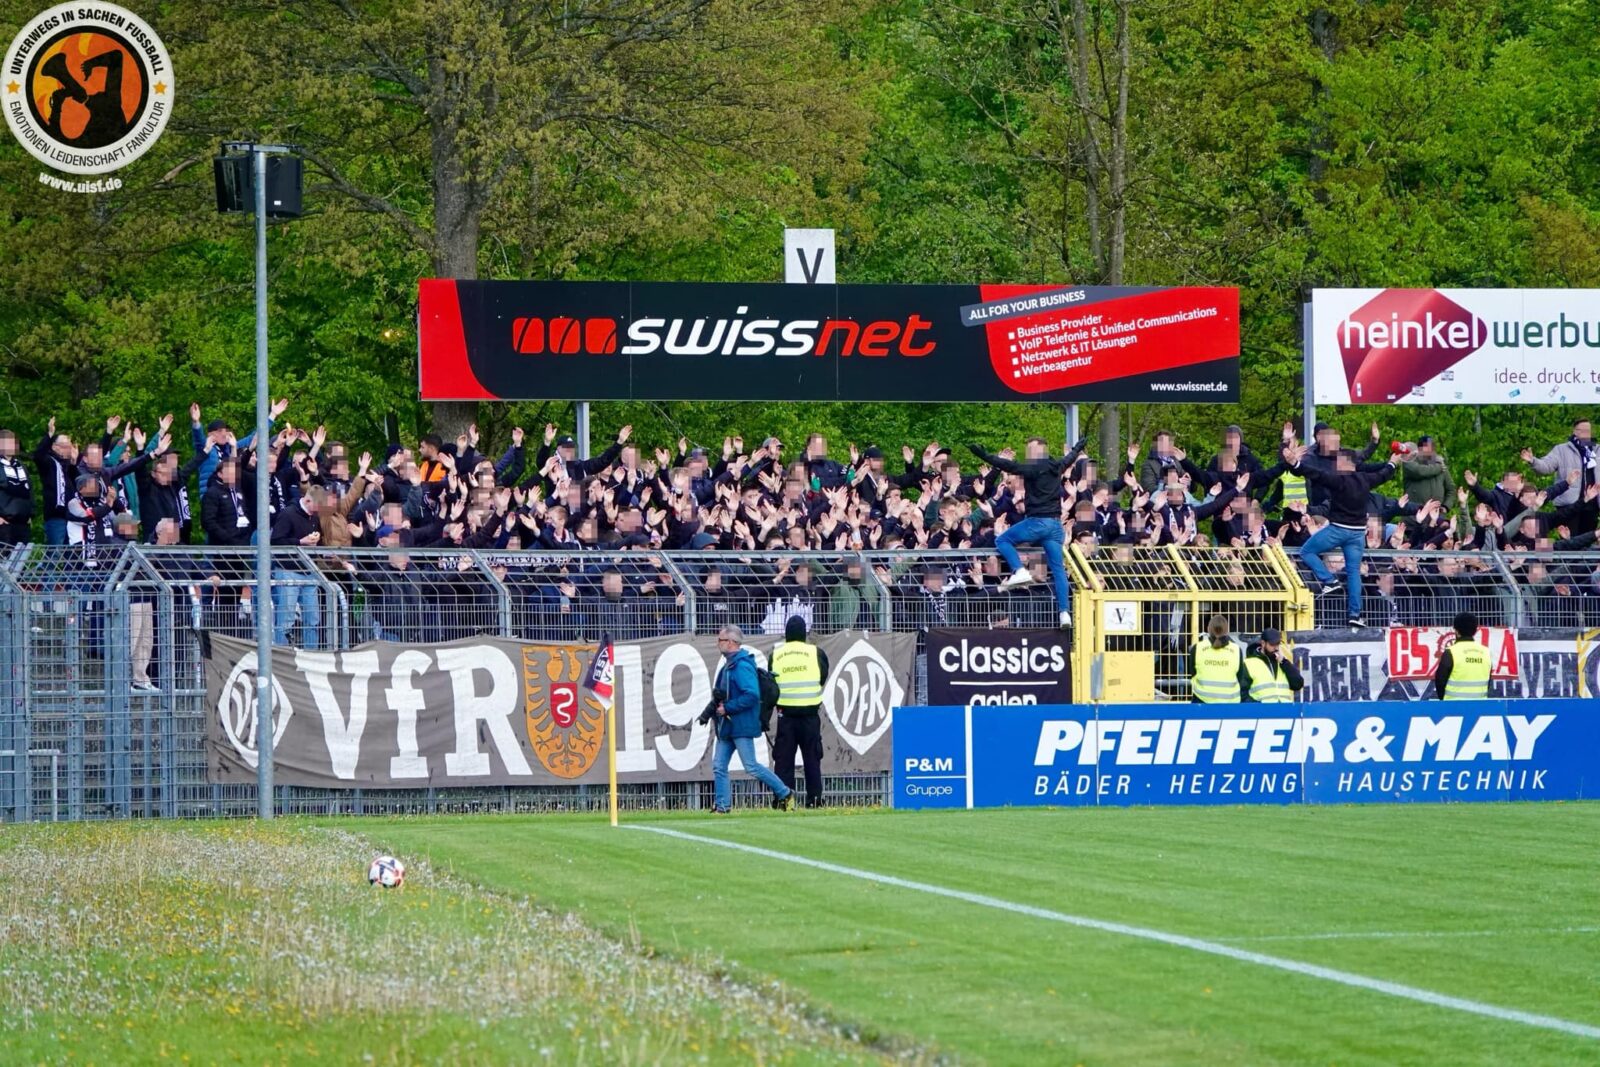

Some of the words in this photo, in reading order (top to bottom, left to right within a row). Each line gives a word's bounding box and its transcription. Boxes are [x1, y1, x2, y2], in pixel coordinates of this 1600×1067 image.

[796, 247, 825, 284] V
[968, 307, 988, 321] ALL
[989, 304, 1009, 318] FOR
[1010, 300, 1039, 314] YOUR
[1039, 291, 1086, 309] BUSINESS
[621, 305, 937, 356] swissnet
[1017, 321, 1060, 338] Business
[1060, 314, 1103, 331] Provider
[1019, 336, 1044, 351] VoIP
[1045, 328, 1090, 347] Telefonie
[1091, 327, 1100, 338] &
[1100, 320, 1136, 338] Unified
[1136, 306, 1218, 331] Communications
[1344, 312, 1479, 349] heinkel
[1021, 347, 1069, 364] Netzwerk
[1070, 343, 1079, 354] &
[1080, 341, 1090, 353] IT
[1091, 333, 1138, 353] Lösungen
[1022, 354, 1093, 377] Werbeagentur
[1494, 368, 1532, 384] idee.
[1537, 368, 1586, 384] druck.
[1150, 382, 1228, 393] www.swissnet.de
[1115, 607, 1127, 624] V
[782, 665, 808, 674] ORDNER
[938, 638, 1065, 674] classics
[294, 644, 533, 781] VfR
[837, 661, 886, 736] VfR
[1034, 718, 1338, 766] PFEIFFER
[1343, 716, 1395, 763] &
[1402, 714, 1558, 761] MAY
[905, 758, 953, 772] P&M
[905, 783, 953, 796] Gruppe
[1034, 771, 1131, 796] BÄDER
[1169, 772, 1298, 795] HEIZUNG
[1338, 769, 1548, 793] HAUSTECHNIK
